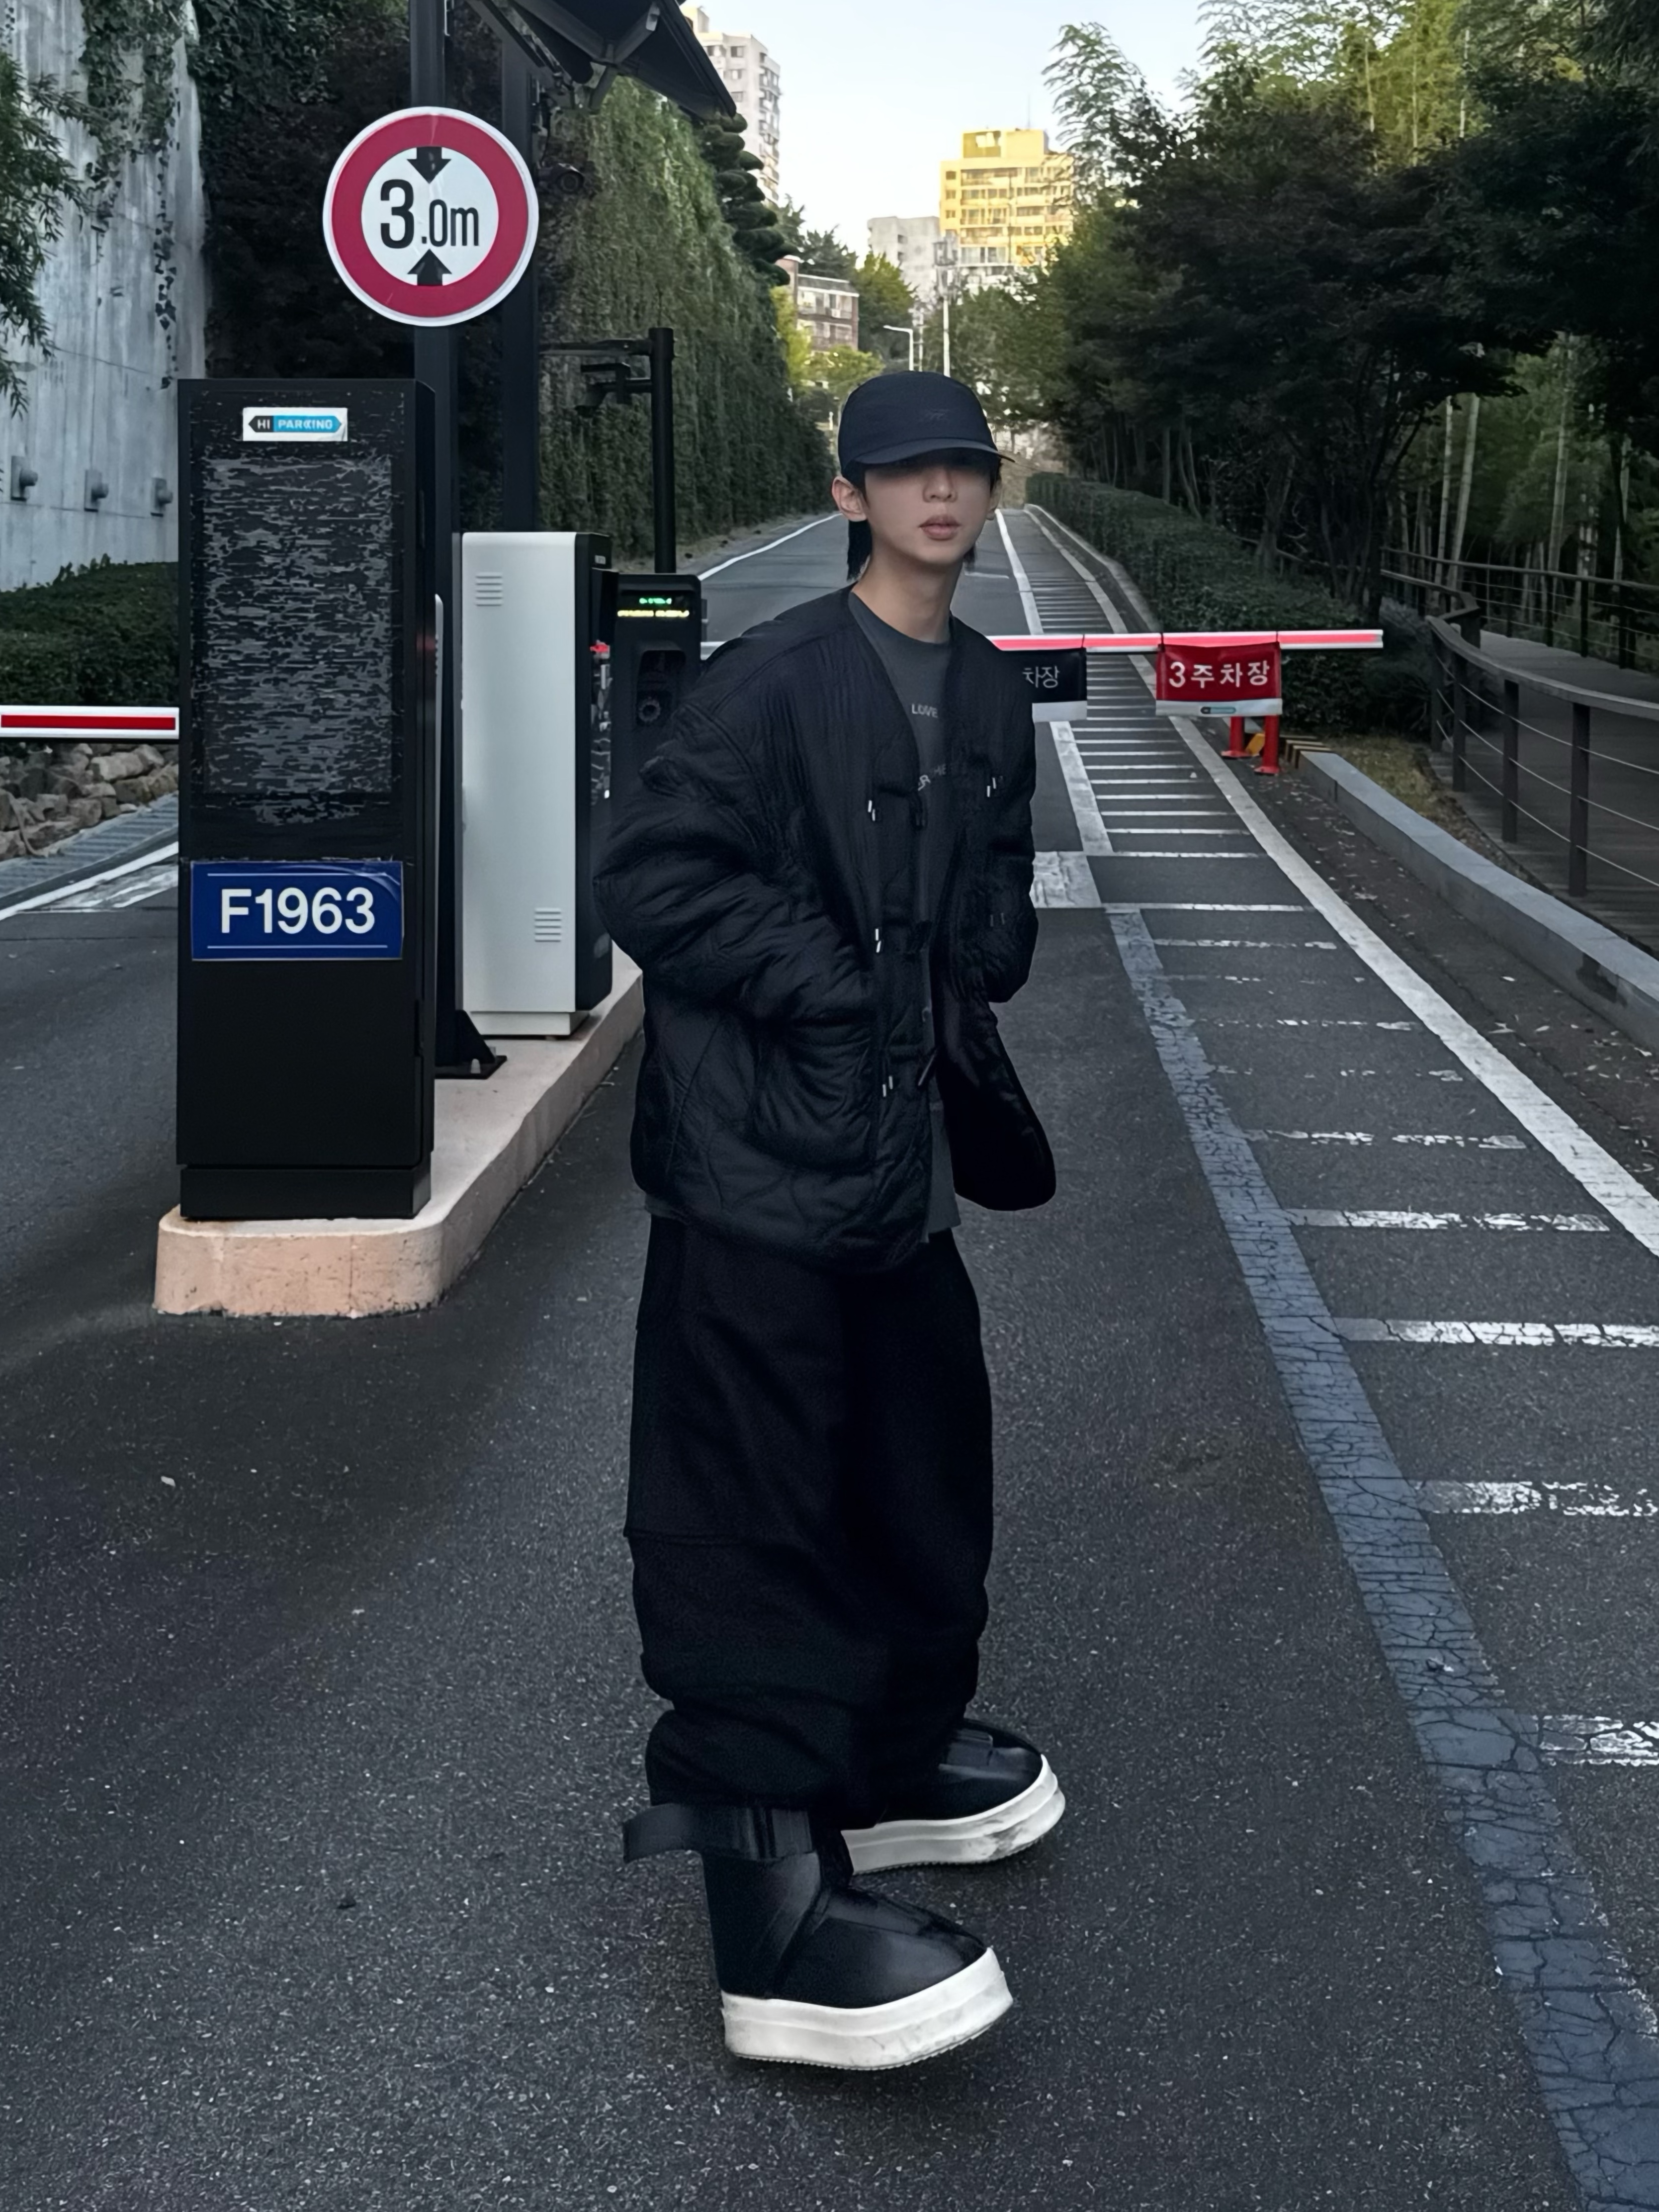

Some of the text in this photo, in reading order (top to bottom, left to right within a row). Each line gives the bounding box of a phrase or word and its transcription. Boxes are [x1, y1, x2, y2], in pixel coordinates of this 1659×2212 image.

[380, 179, 479, 249] 3.0m
[257, 419, 333, 430] HI PARKING
[1169, 660, 1270, 688] 3주차장
[221, 887, 375, 935] F1963
